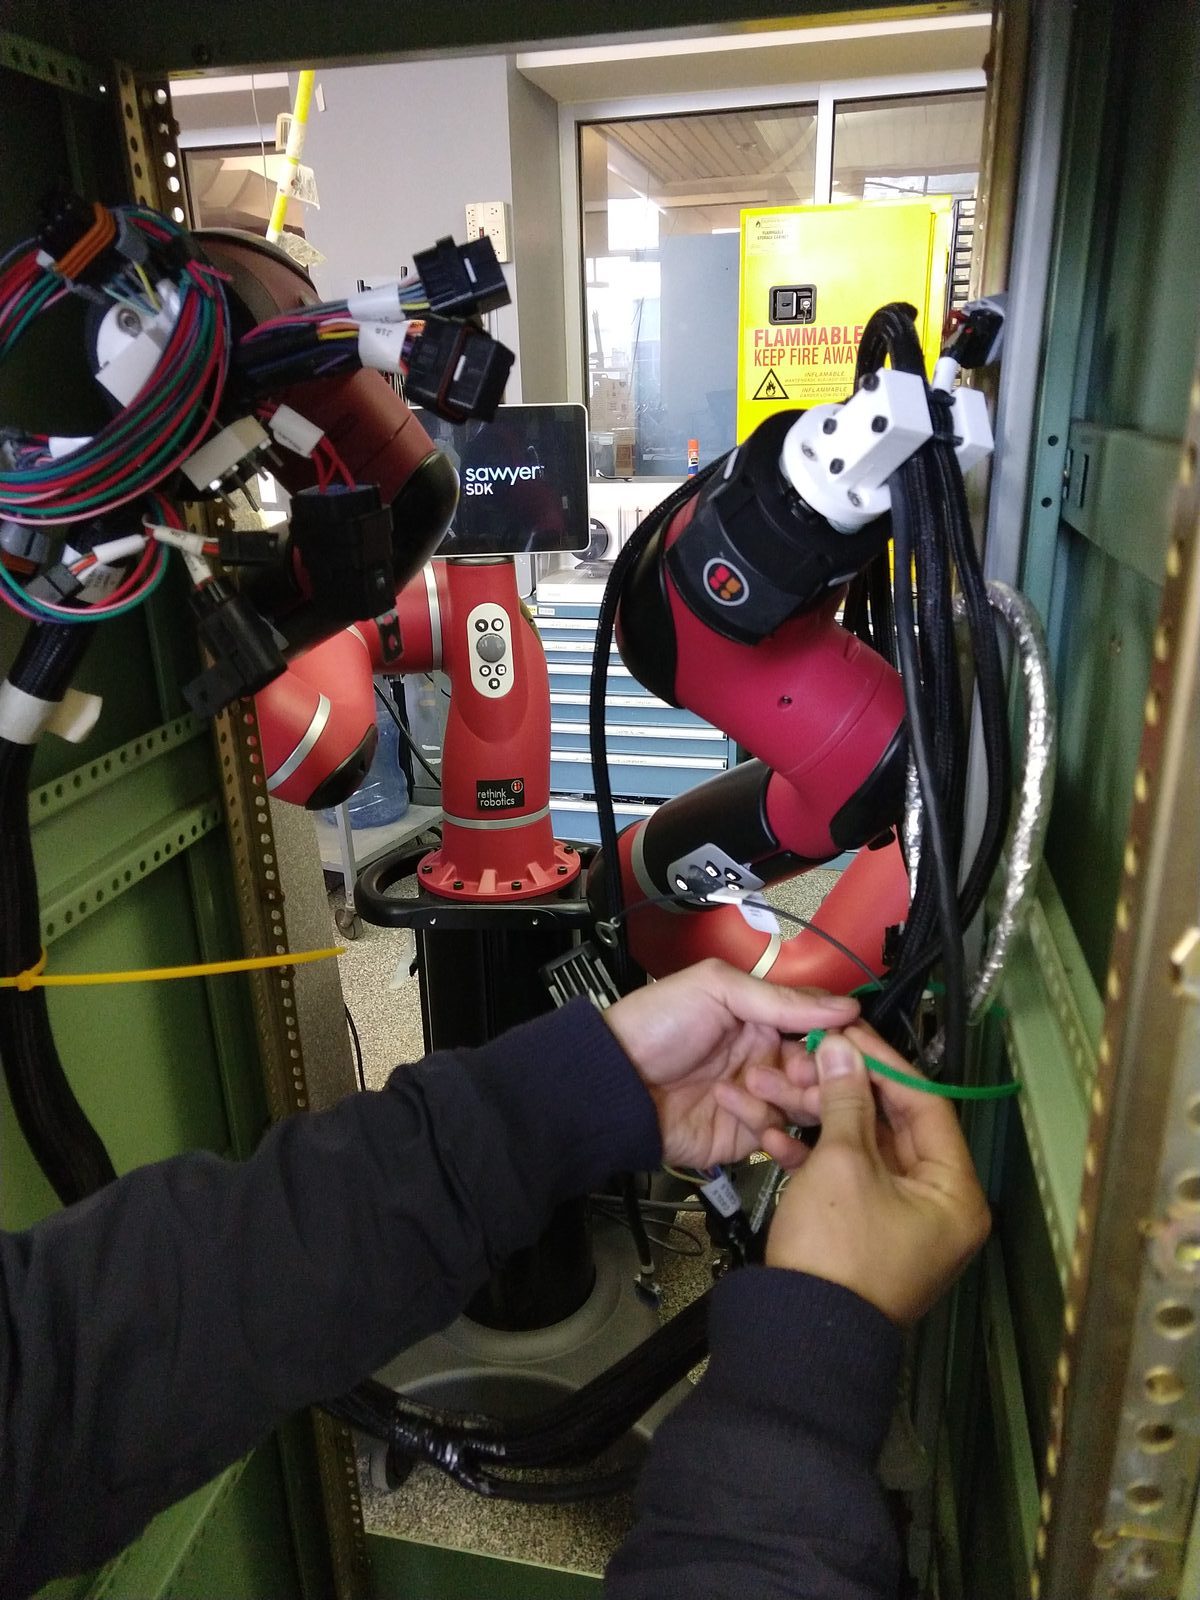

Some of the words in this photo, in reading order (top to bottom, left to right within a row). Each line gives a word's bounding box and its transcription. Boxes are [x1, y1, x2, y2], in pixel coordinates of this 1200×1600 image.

[754, 326, 864, 347] FLAMMABLE
[754, 348, 786, 367] KEEP
[790, 347, 819, 365] FIRE
[465, 465, 541, 486] sawyer
[465, 483, 494, 496] SDK
[477, 788, 507, 799] rethink
[480, 797, 515, 807] robotics
